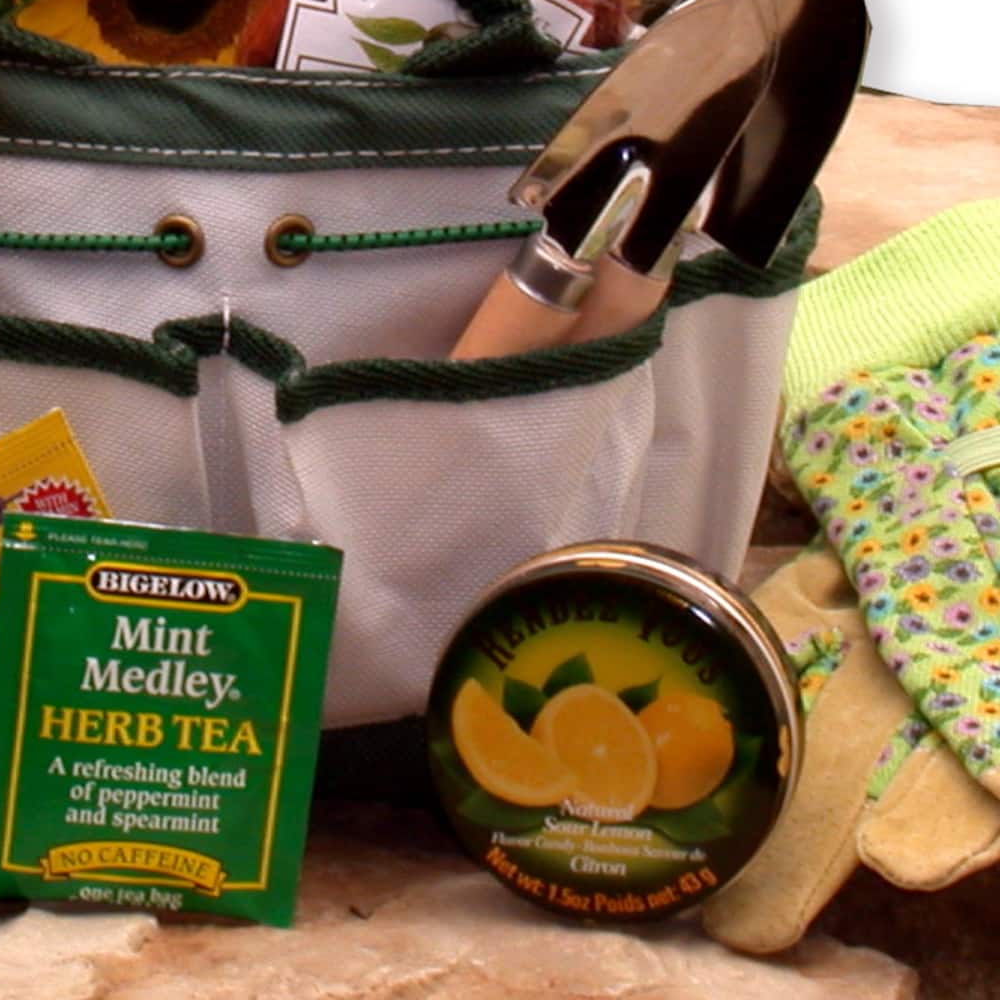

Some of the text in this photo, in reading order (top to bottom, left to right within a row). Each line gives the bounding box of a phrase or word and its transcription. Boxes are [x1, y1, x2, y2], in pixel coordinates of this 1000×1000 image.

[98, 571, 235, 601] BIGELOW
[110, 615, 213, 656] Mint
[80, 656, 237, 710] Medley
[39, 704, 262, 755] HERB TEA
[48, 756, 247, 789] A refreshing blend
[70, 782, 220, 811] of peppermint
[560, 799, 634, 821] Natural
[65, 807, 219, 834] and spearmint
[545, 816, 653, 840] Sour Lemon
[60, 848, 211, 880] NO CAFFEINE
[485, 847, 518, 880] Net
[570, 855, 627, 876] Citron
